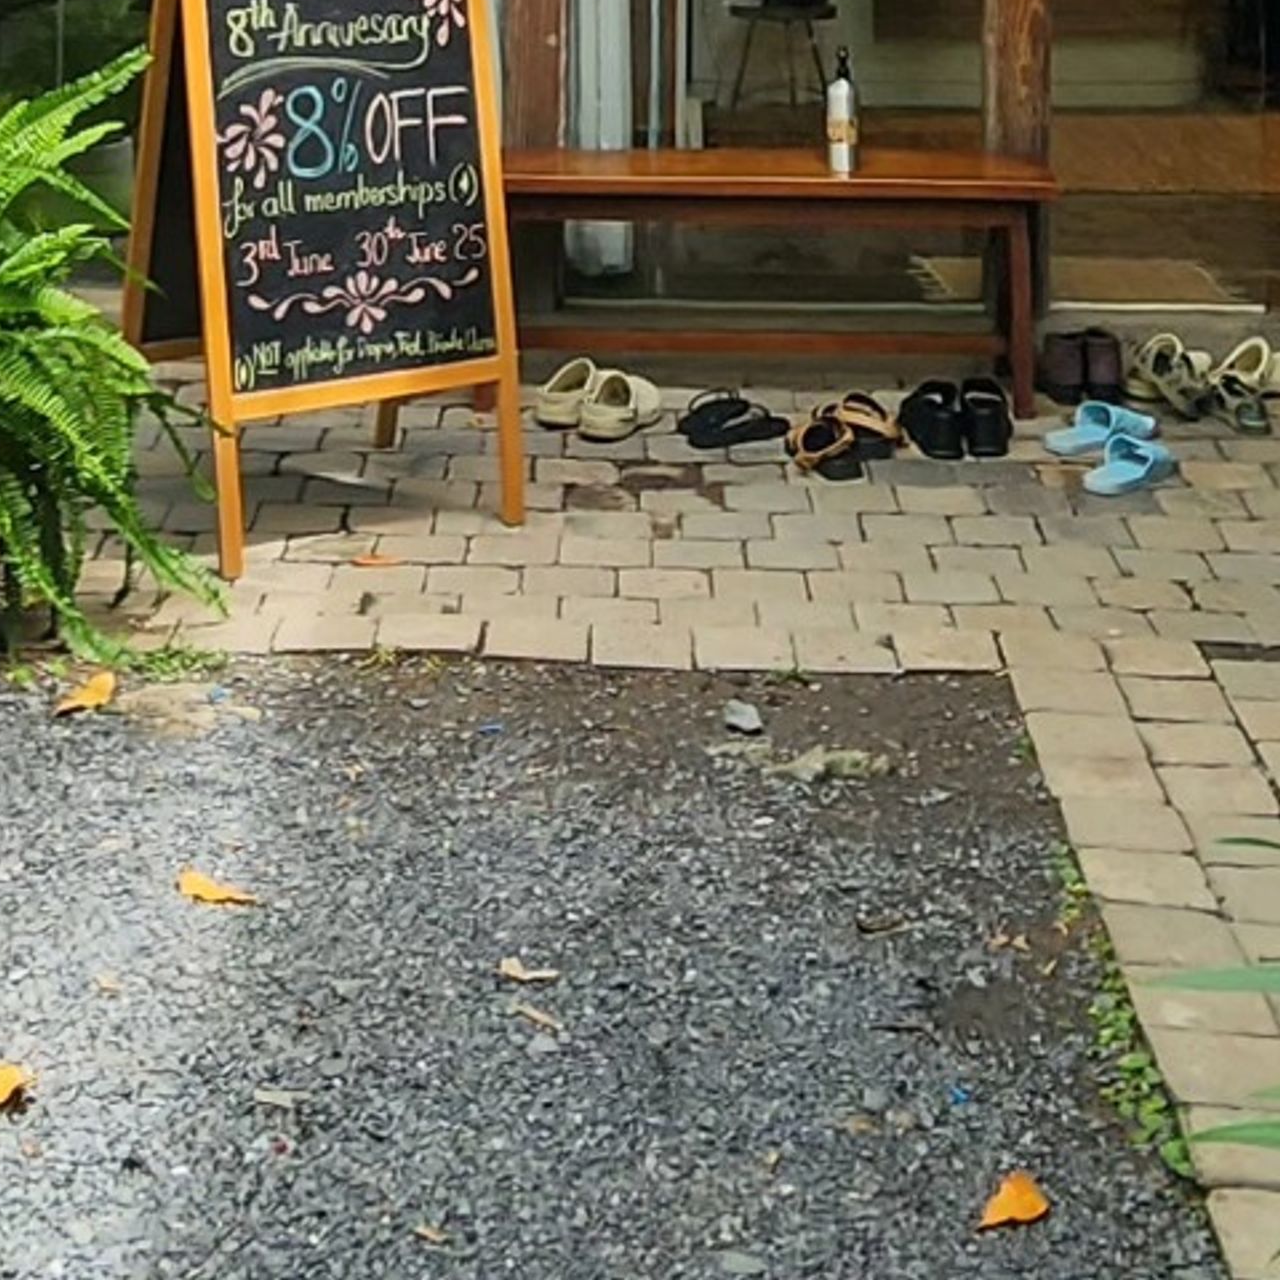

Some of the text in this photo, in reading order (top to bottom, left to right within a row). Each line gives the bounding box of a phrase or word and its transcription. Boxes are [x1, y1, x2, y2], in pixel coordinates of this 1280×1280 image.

[286, 77, 469, 178] 8% OFF
[222, 176, 255, 238] for
[262, 180, 297, 217] all
[235, 225, 282, 287] 3rd
[283, 240, 335, 277] June
[252, 341, 282, 366] NOT
